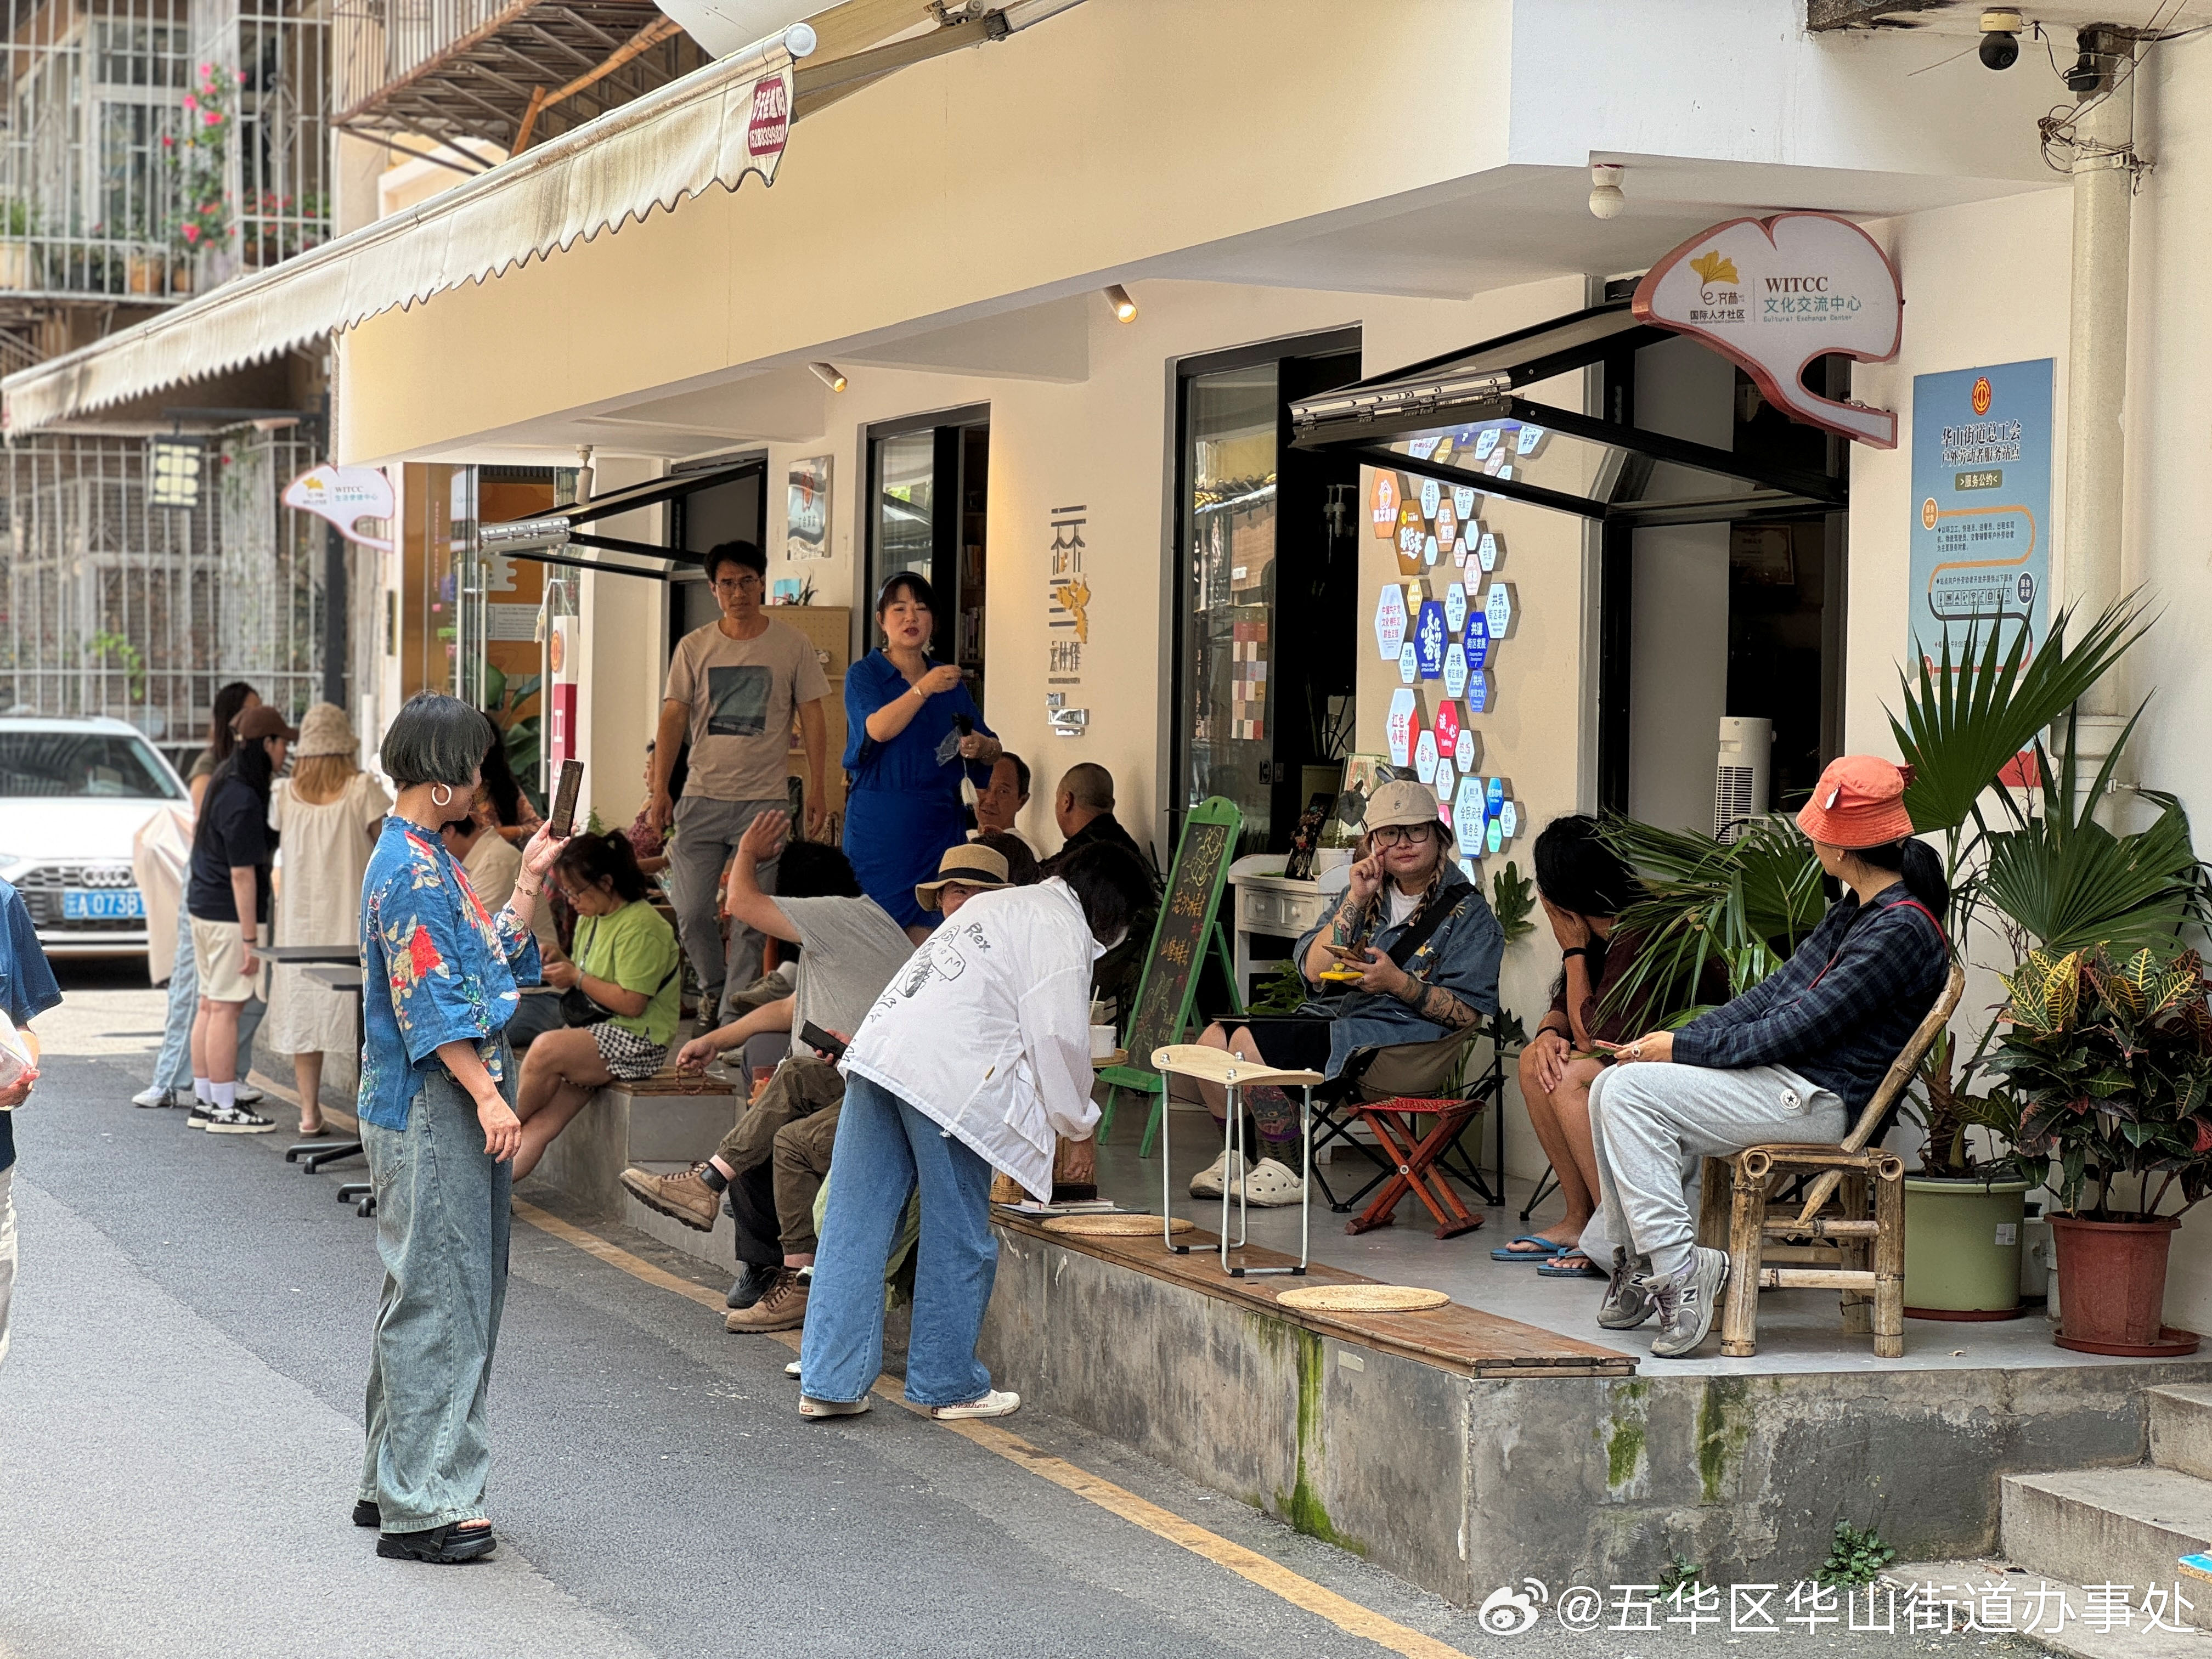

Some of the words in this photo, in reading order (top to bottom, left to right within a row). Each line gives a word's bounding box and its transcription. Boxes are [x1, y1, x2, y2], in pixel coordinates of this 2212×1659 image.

[1765, 276, 1829, 293] WITCC
[1764, 295, 1862, 313] 文化交流中心
[1690, 309, 1746, 320] 国际人才社区
[1942, 419, 2022, 448] 华山街道总工会
[1940, 443, 2021, 468] 户外劳动者服务站点
[1965, 473, 1993, 488] 服务公约
[1467, 638, 1486, 650] 街区发展
[1392, 713, 1404, 729] 红色
[1391, 730, 1404, 746] 小哥
[963, 922, 991, 953] Rex
